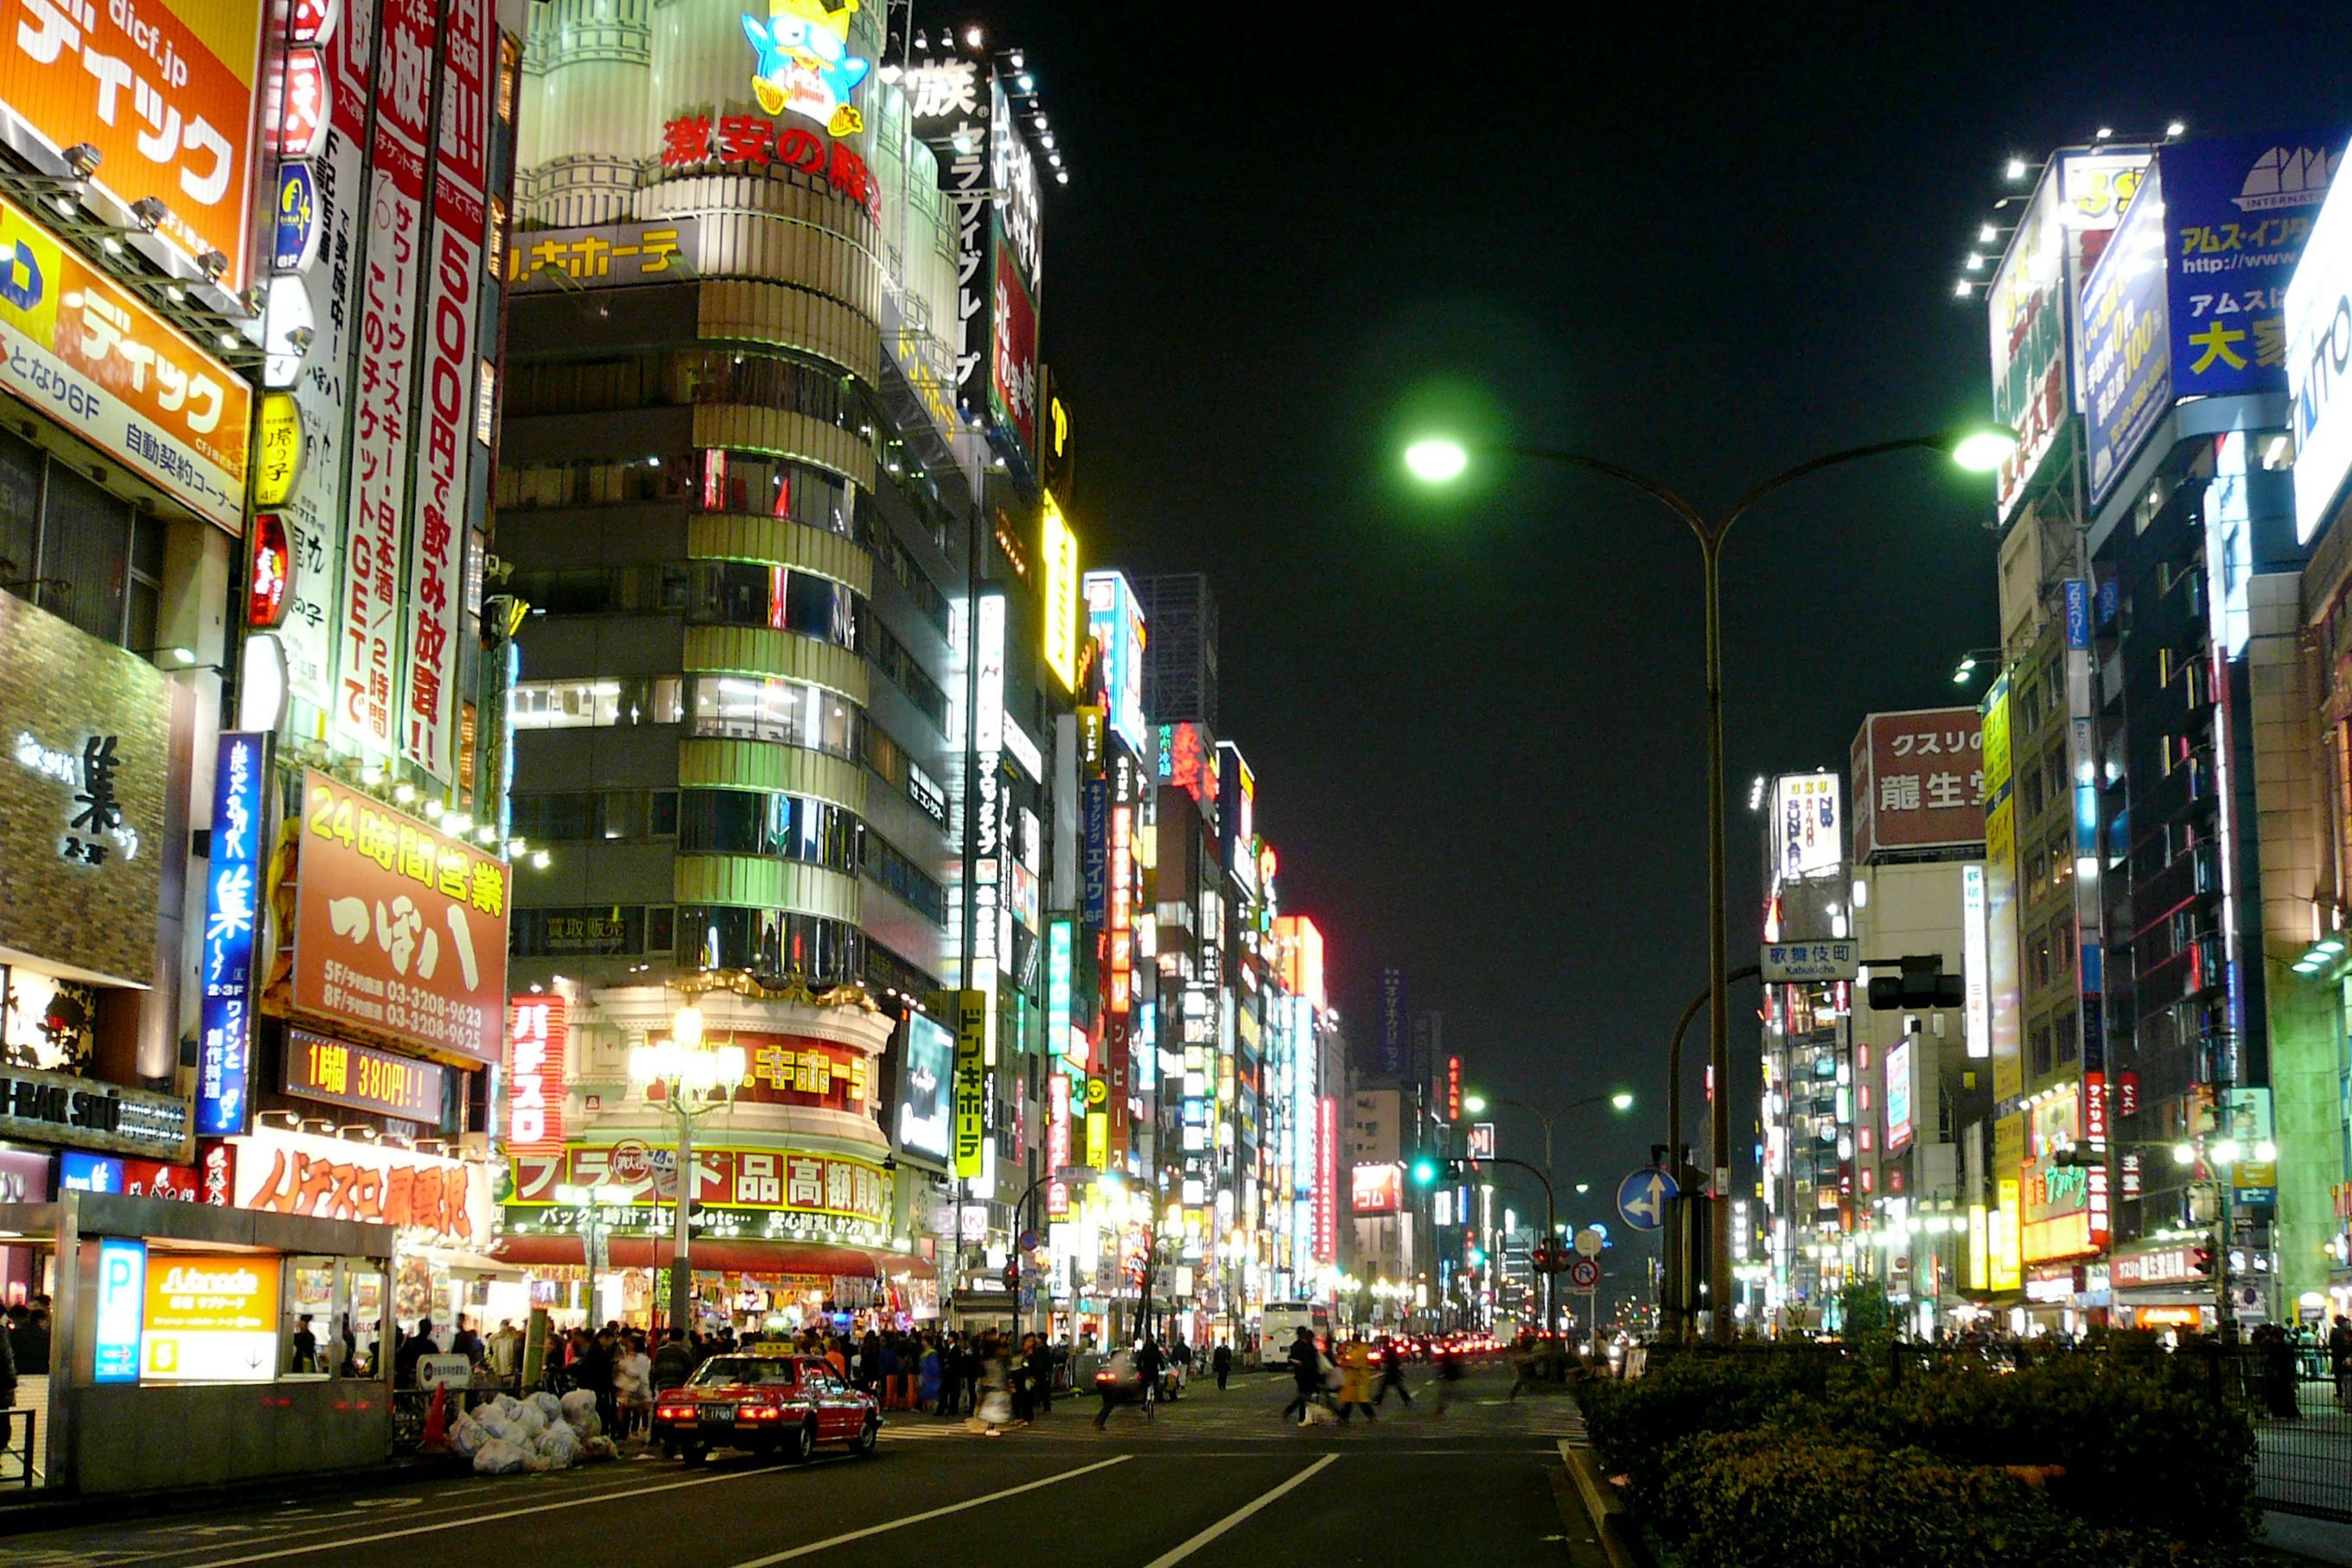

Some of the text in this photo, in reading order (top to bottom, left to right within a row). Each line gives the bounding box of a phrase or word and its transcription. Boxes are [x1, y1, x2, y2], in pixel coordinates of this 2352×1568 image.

[9, 345, 101, 421] となり6F
[80, 286, 225, 434] ディック
[125, 422, 241, 513] 自動契約コーナー
[265, 427, 292, 481] 虎の子
[309, 785, 503, 919] 24時間営業
[328, 895, 480, 992] つぼ八
[1769, 944, 1850, 964] 歌舞伎町
[1785, 965, 1836, 976] Kabukicho
[386, 1003, 481, 1051] 03-3208-9625
[387, 979, 483, 1029] 03-3208-9623
[309, 1042, 424, 1109] 1時間 380円!!
[510, 1004, 550, 1143] パチスロ
